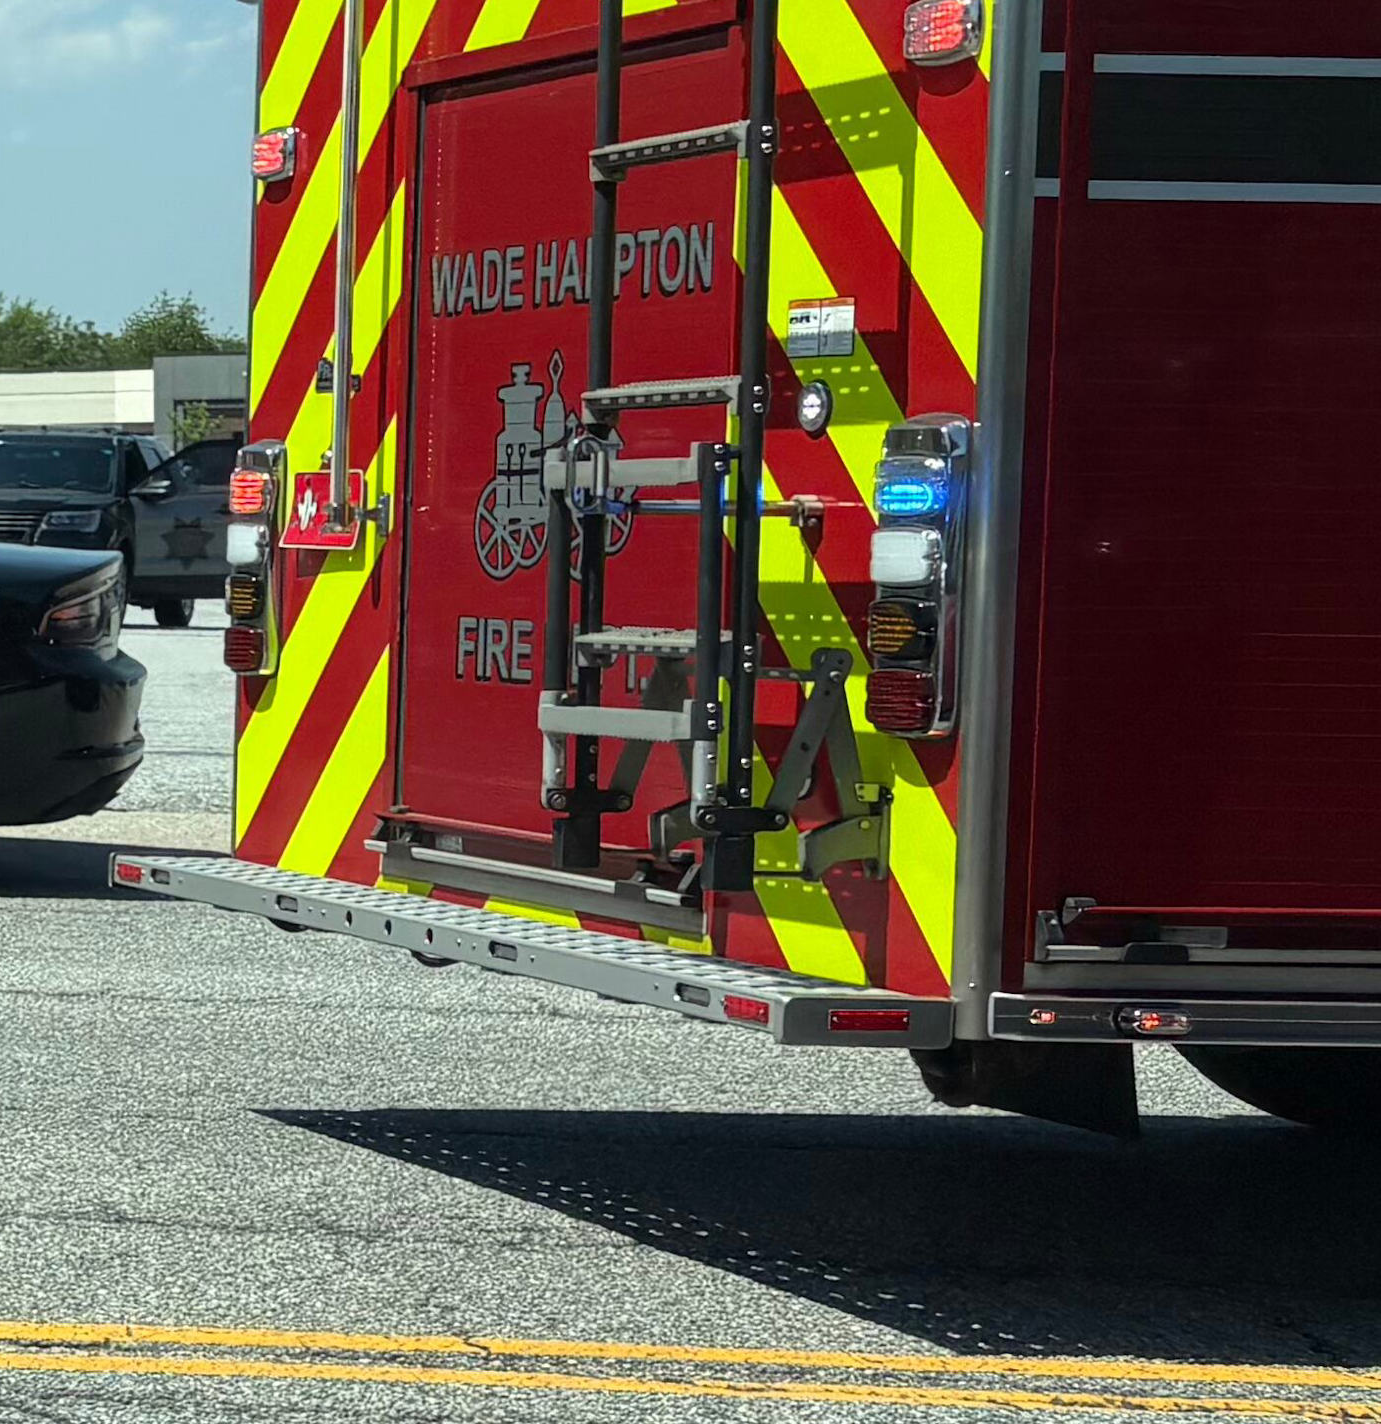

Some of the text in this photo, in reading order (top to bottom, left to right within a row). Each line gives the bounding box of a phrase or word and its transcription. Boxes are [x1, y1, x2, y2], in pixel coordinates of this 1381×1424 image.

[431, 222, 715, 316] WADE HAPTON
[457, 616, 535, 682] FIRE
